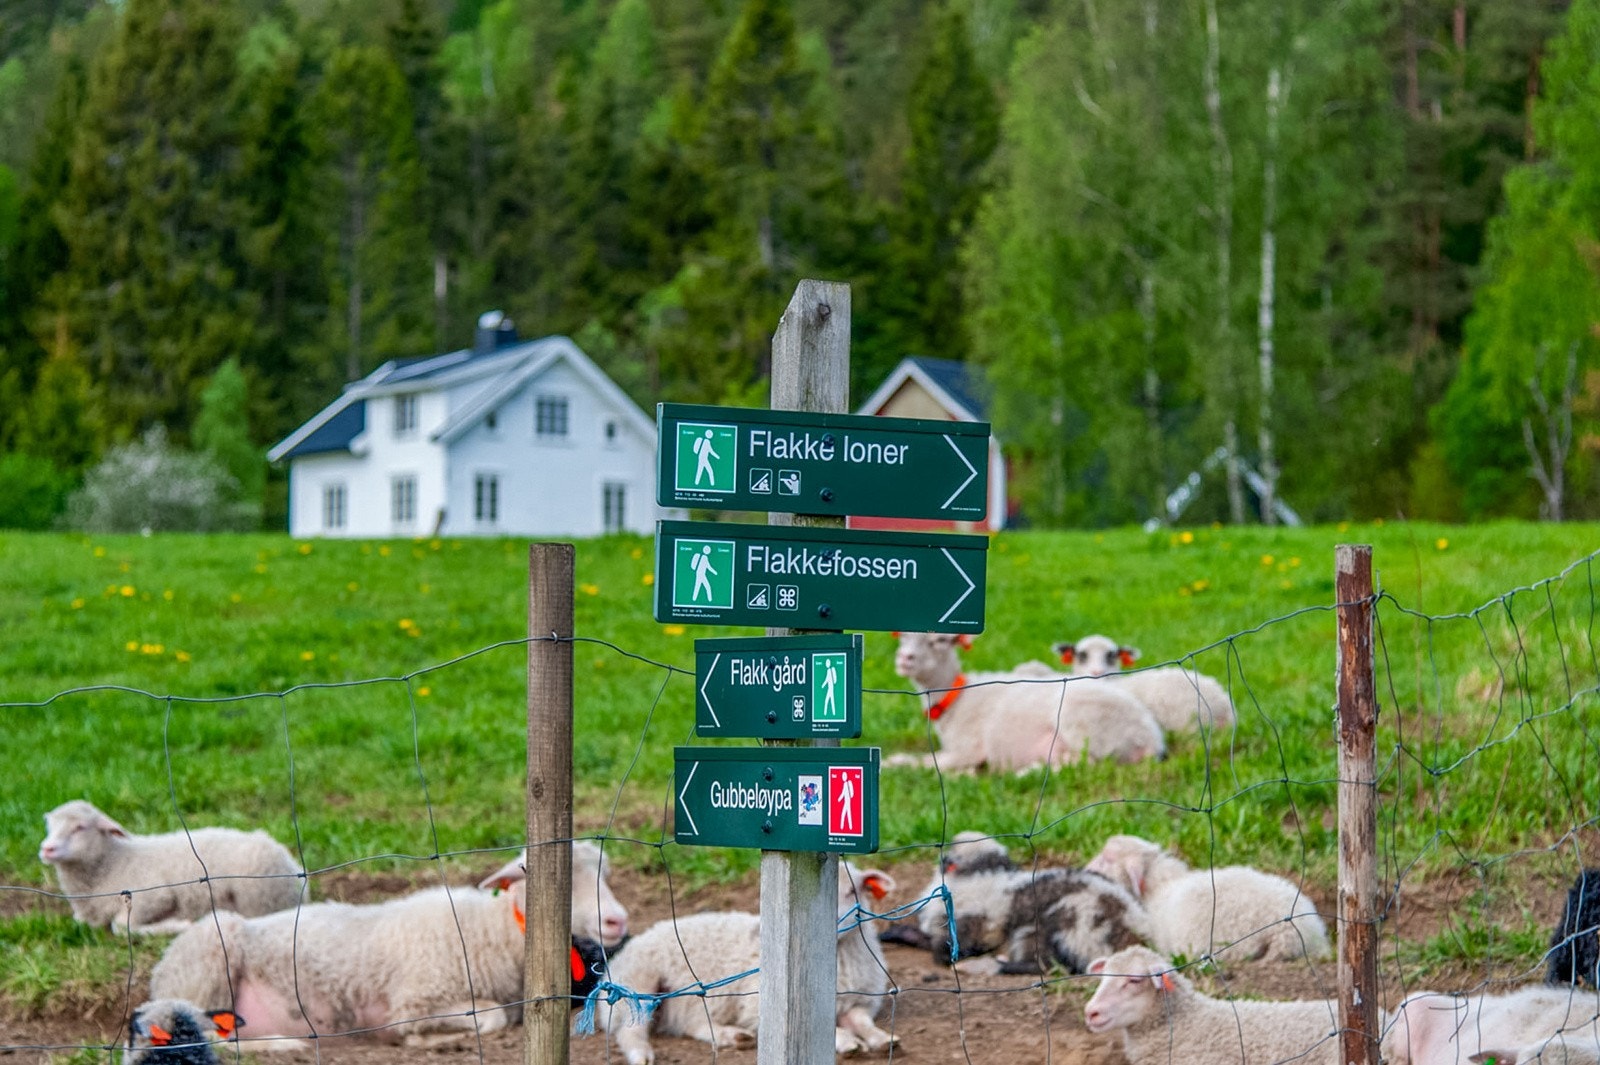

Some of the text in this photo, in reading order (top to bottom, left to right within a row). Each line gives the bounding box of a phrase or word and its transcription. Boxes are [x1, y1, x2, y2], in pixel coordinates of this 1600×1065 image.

[748, 429, 909, 465] Flakke loner
[747, 545, 917, 579] Flakkefossen
[730, 656, 806, 692] Flakk gård
[710, 780, 792, 816] Gubbeløypa
